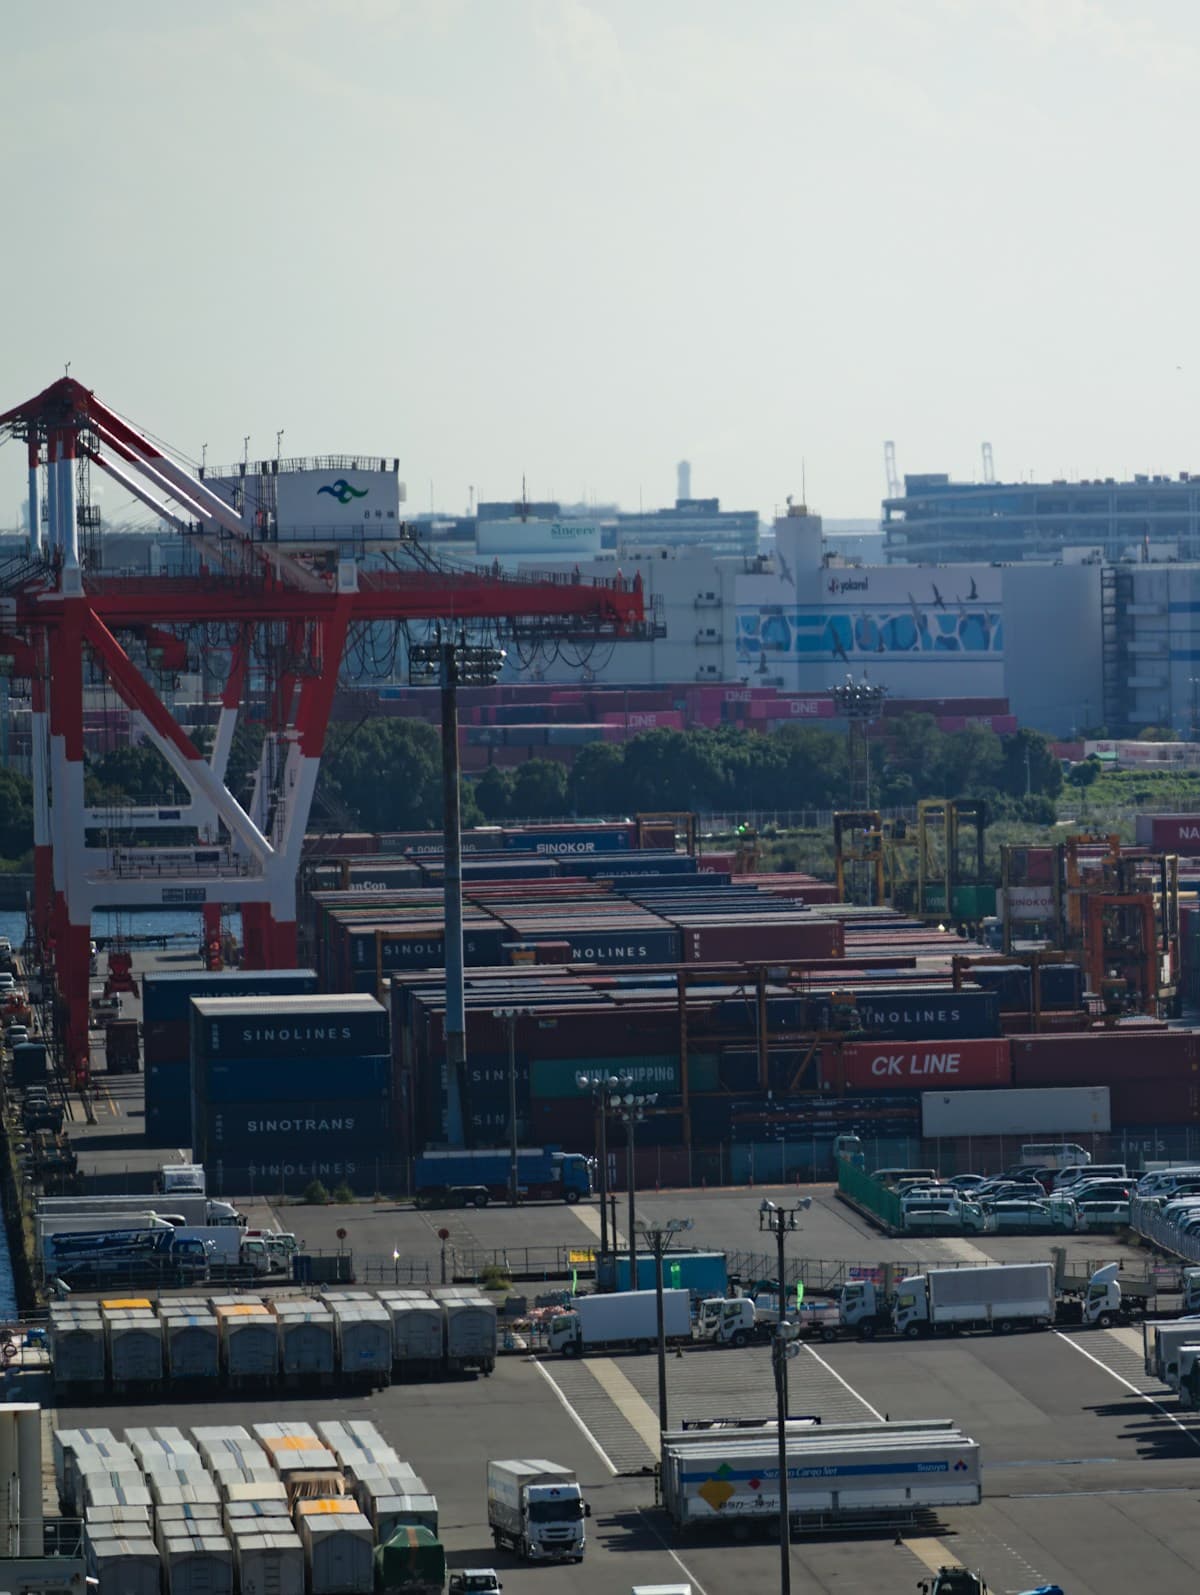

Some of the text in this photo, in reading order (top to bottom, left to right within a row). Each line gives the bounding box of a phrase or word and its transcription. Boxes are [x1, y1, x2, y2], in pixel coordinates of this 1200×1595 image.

[791, 701, 818, 714] ONE
[629, 714, 656, 728] ONE
[537, 842, 595, 855] SINOKOR
[572, 946, 648, 959] NOLINES
[242, 1026, 352, 1041] SINOLINES
[871, 1053, 961, 1075] CK LINE
[619, 1066, 675, 1082] SHIPPING
[247, 1117, 356, 1132] SINOTRANS
[248, 1161, 356, 1177] SINOLINES
